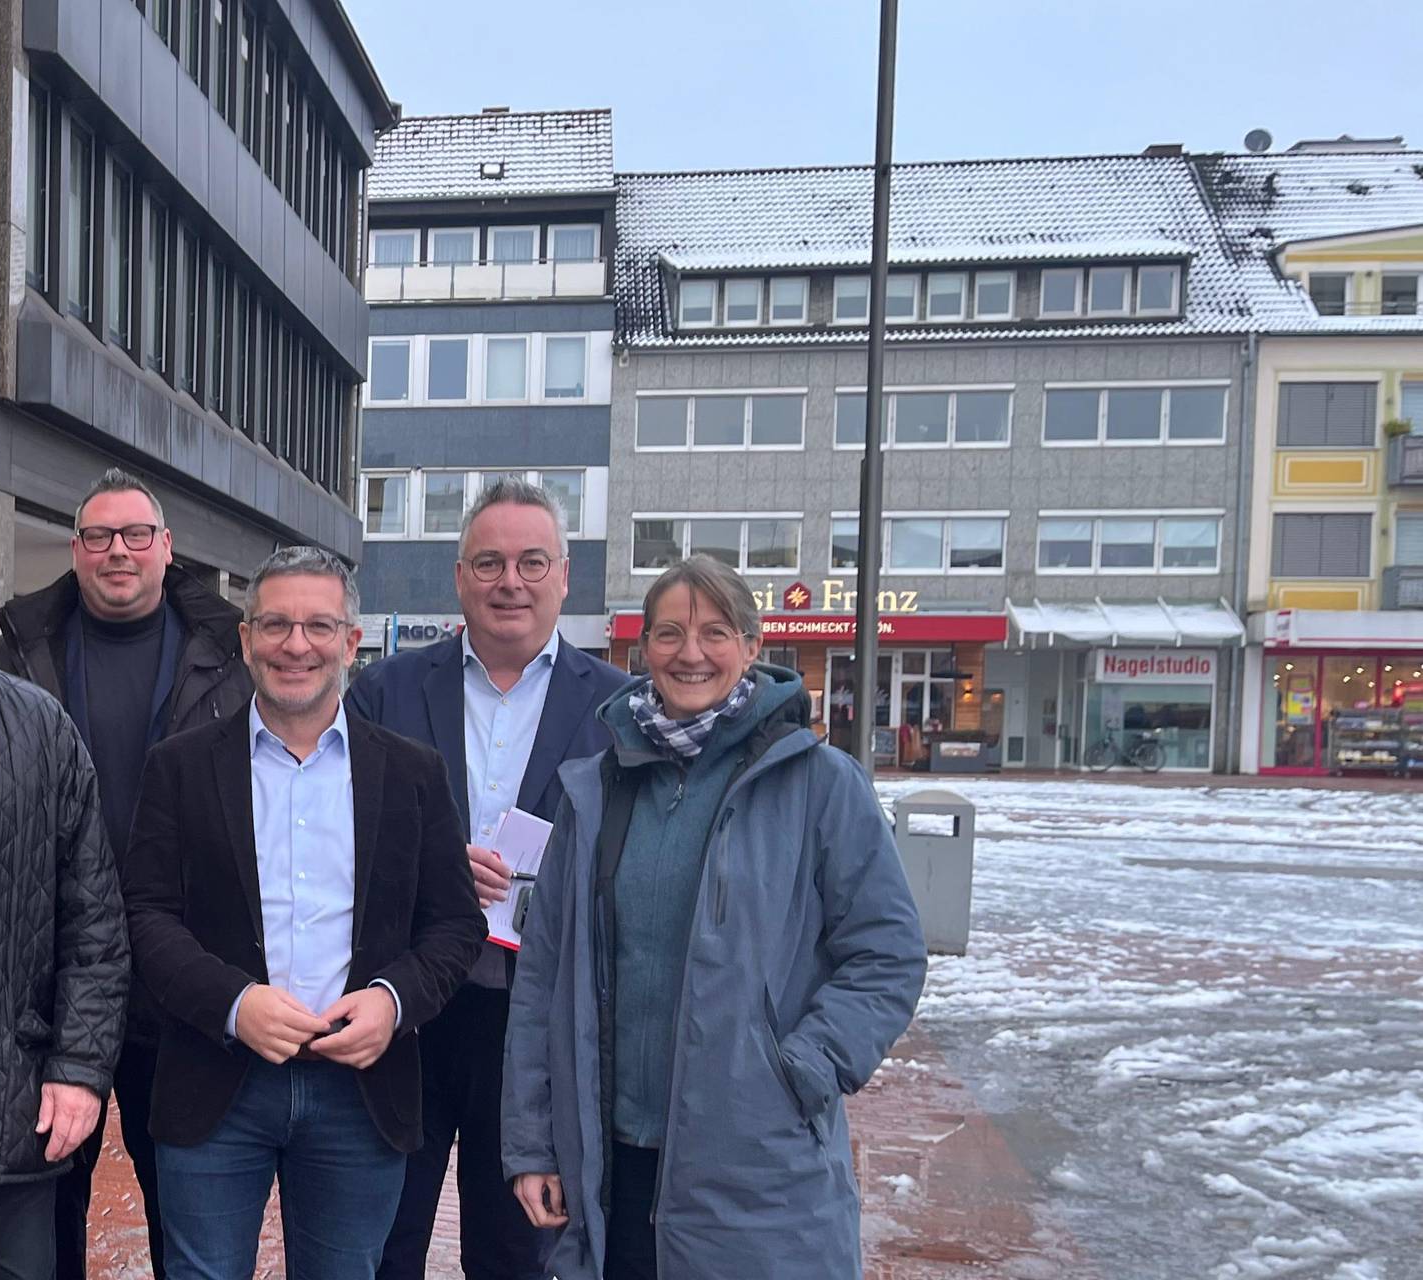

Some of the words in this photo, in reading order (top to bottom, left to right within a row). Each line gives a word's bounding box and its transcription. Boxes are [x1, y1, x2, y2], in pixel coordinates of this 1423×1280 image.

[752, 582, 776, 611] si
[822, 580, 918, 612] Frnz
[398, 625, 437, 640] RGO
[788, 621, 850, 633] SCHMECKT
[852, 621, 895, 633] SN.
[1104, 655, 1210, 676] Nagelstudio
